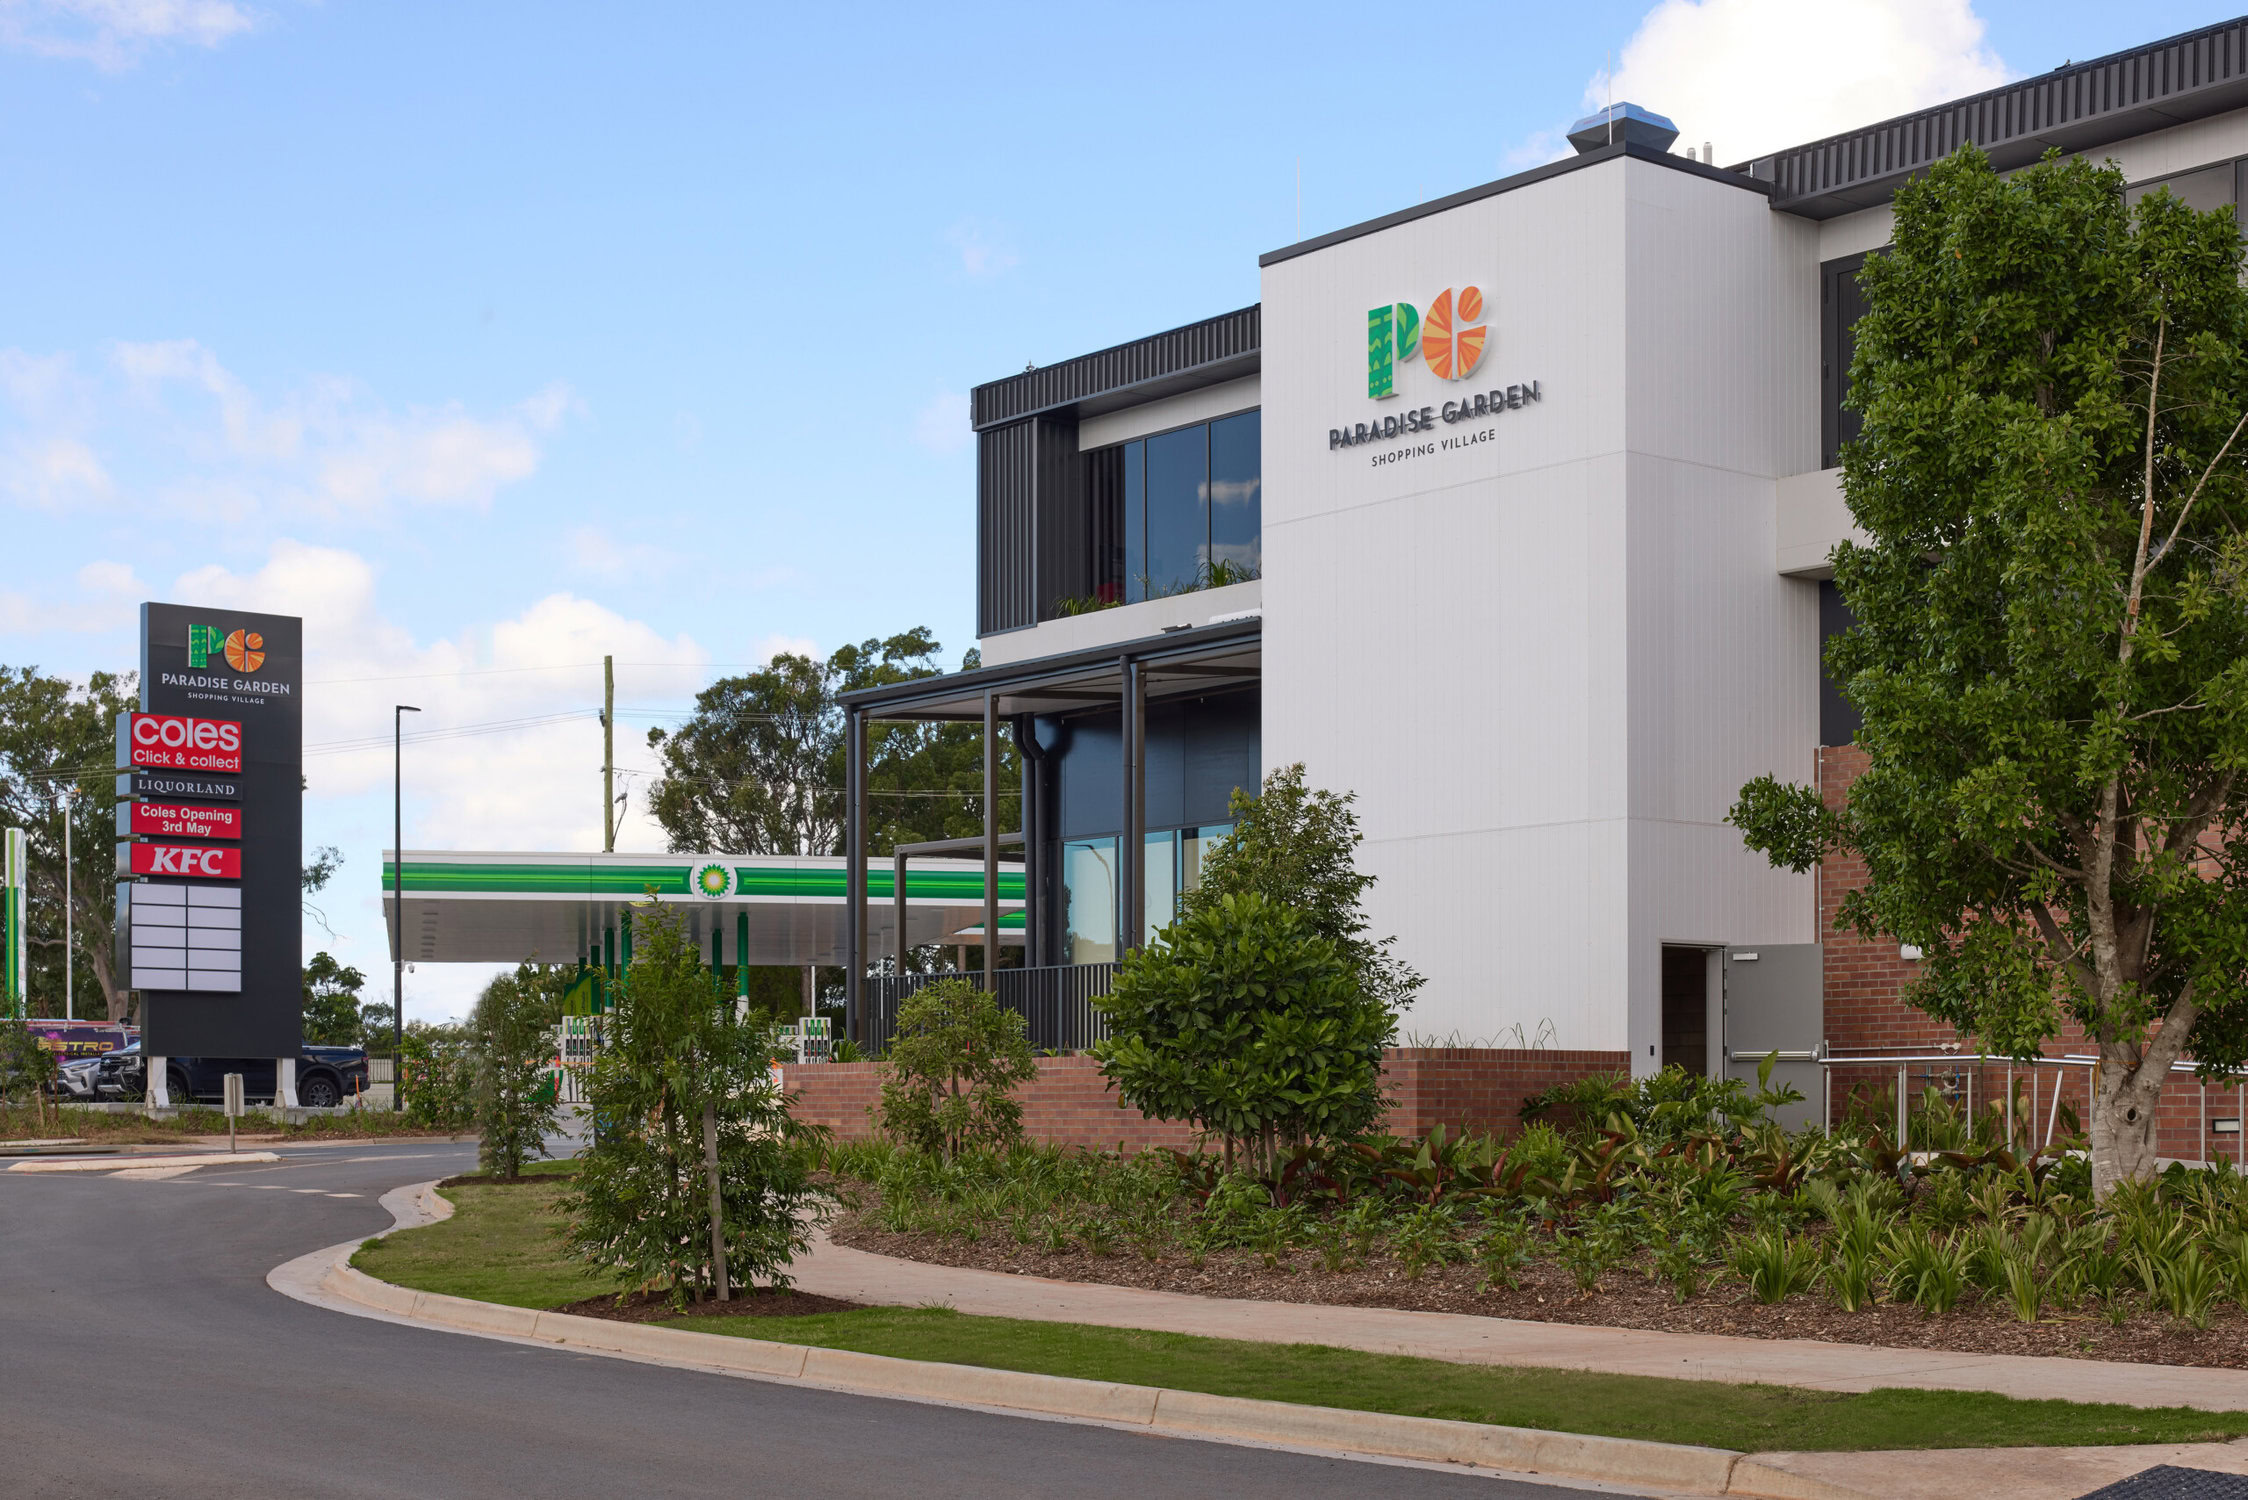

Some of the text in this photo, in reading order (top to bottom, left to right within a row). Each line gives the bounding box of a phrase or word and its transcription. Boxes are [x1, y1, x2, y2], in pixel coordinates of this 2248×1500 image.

[1329, 380, 1541, 450] PARADISE GARDEN
[1371, 428, 1496, 467] SHOPPING VILLAGE
[161, 673, 290, 695] PARADISE GARDEN
[187, 692, 265, 705] SHOPPING VILLAGE
[133, 717, 240, 751] coles
[133, 749, 240, 769] Click & collect
[138, 779, 236, 795] LIQUORLAND
[140, 805, 233, 824] Coles Opening
[162, 820, 212, 837] 3rd May
[149, 847, 224, 875] KFC
